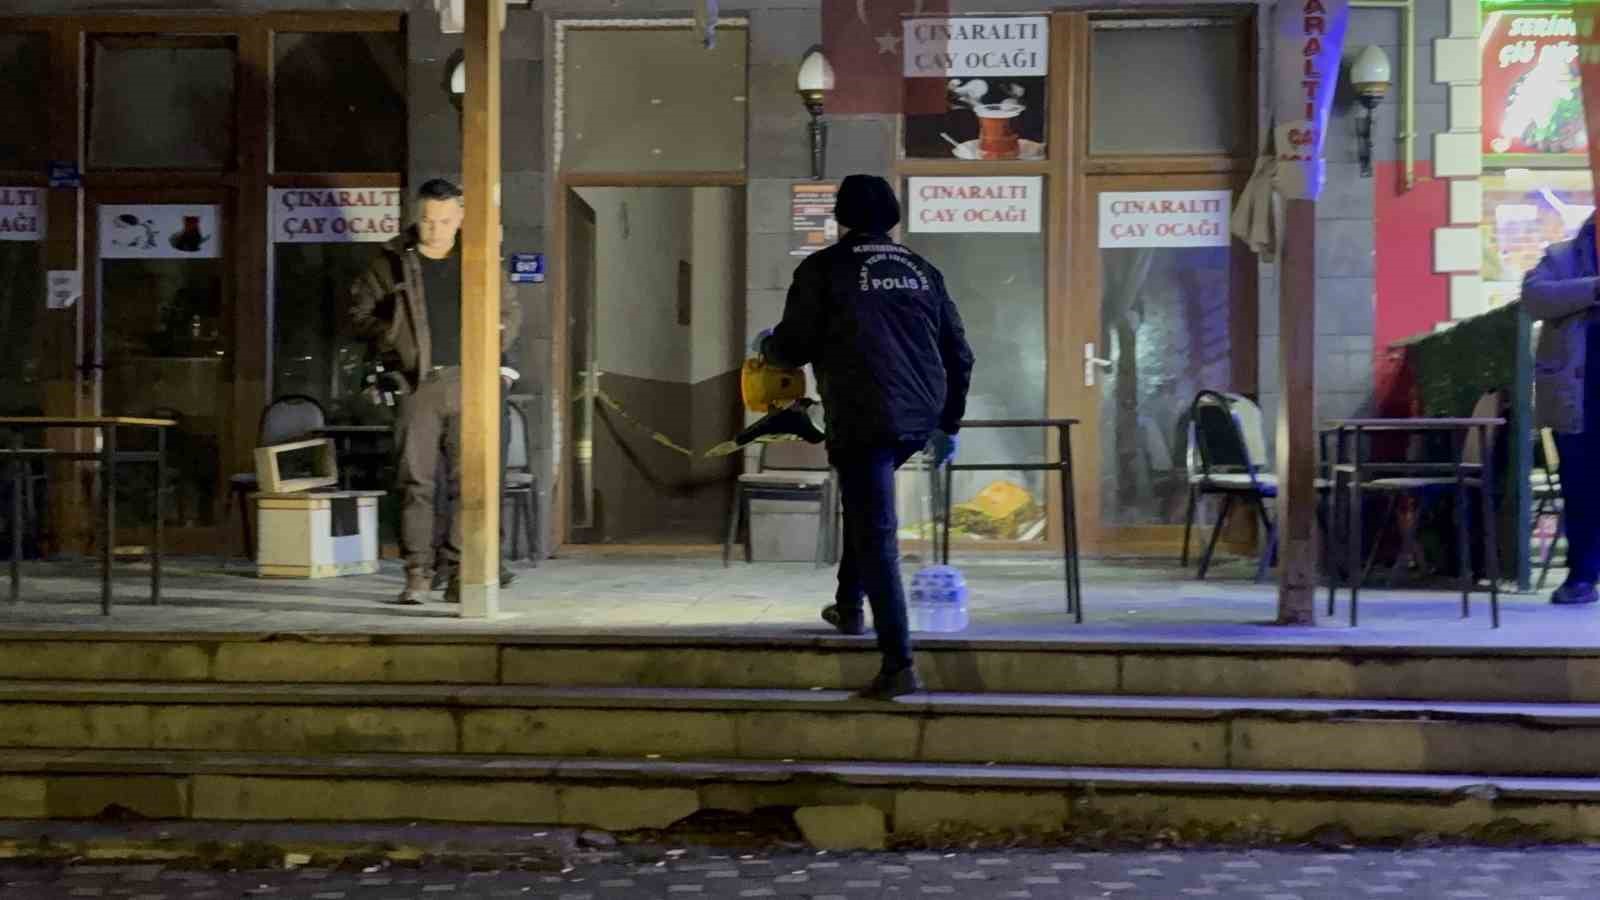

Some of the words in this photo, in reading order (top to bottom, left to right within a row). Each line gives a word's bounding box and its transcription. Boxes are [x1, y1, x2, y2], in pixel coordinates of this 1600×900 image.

[914, 23, 1039, 44] ÇINARALTI
[914, 52, 959, 69] ÇAY
[965, 48, 1038, 68] OCAĞI
[919, 185, 1028, 203] ÇINARALTI
[919, 208, 957, 226] ÇAY
[963, 205, 1028, 223] OCAĞI
[1109, 199, 1221, 217] ÇINARALTI
[283, 217, 326, 239] ÇAY
[1109, 223, 1149, 240] ÇAY
[1155, 219, 1221, 237] OCAĞI
[871, 276, 919, 291] POLİS
